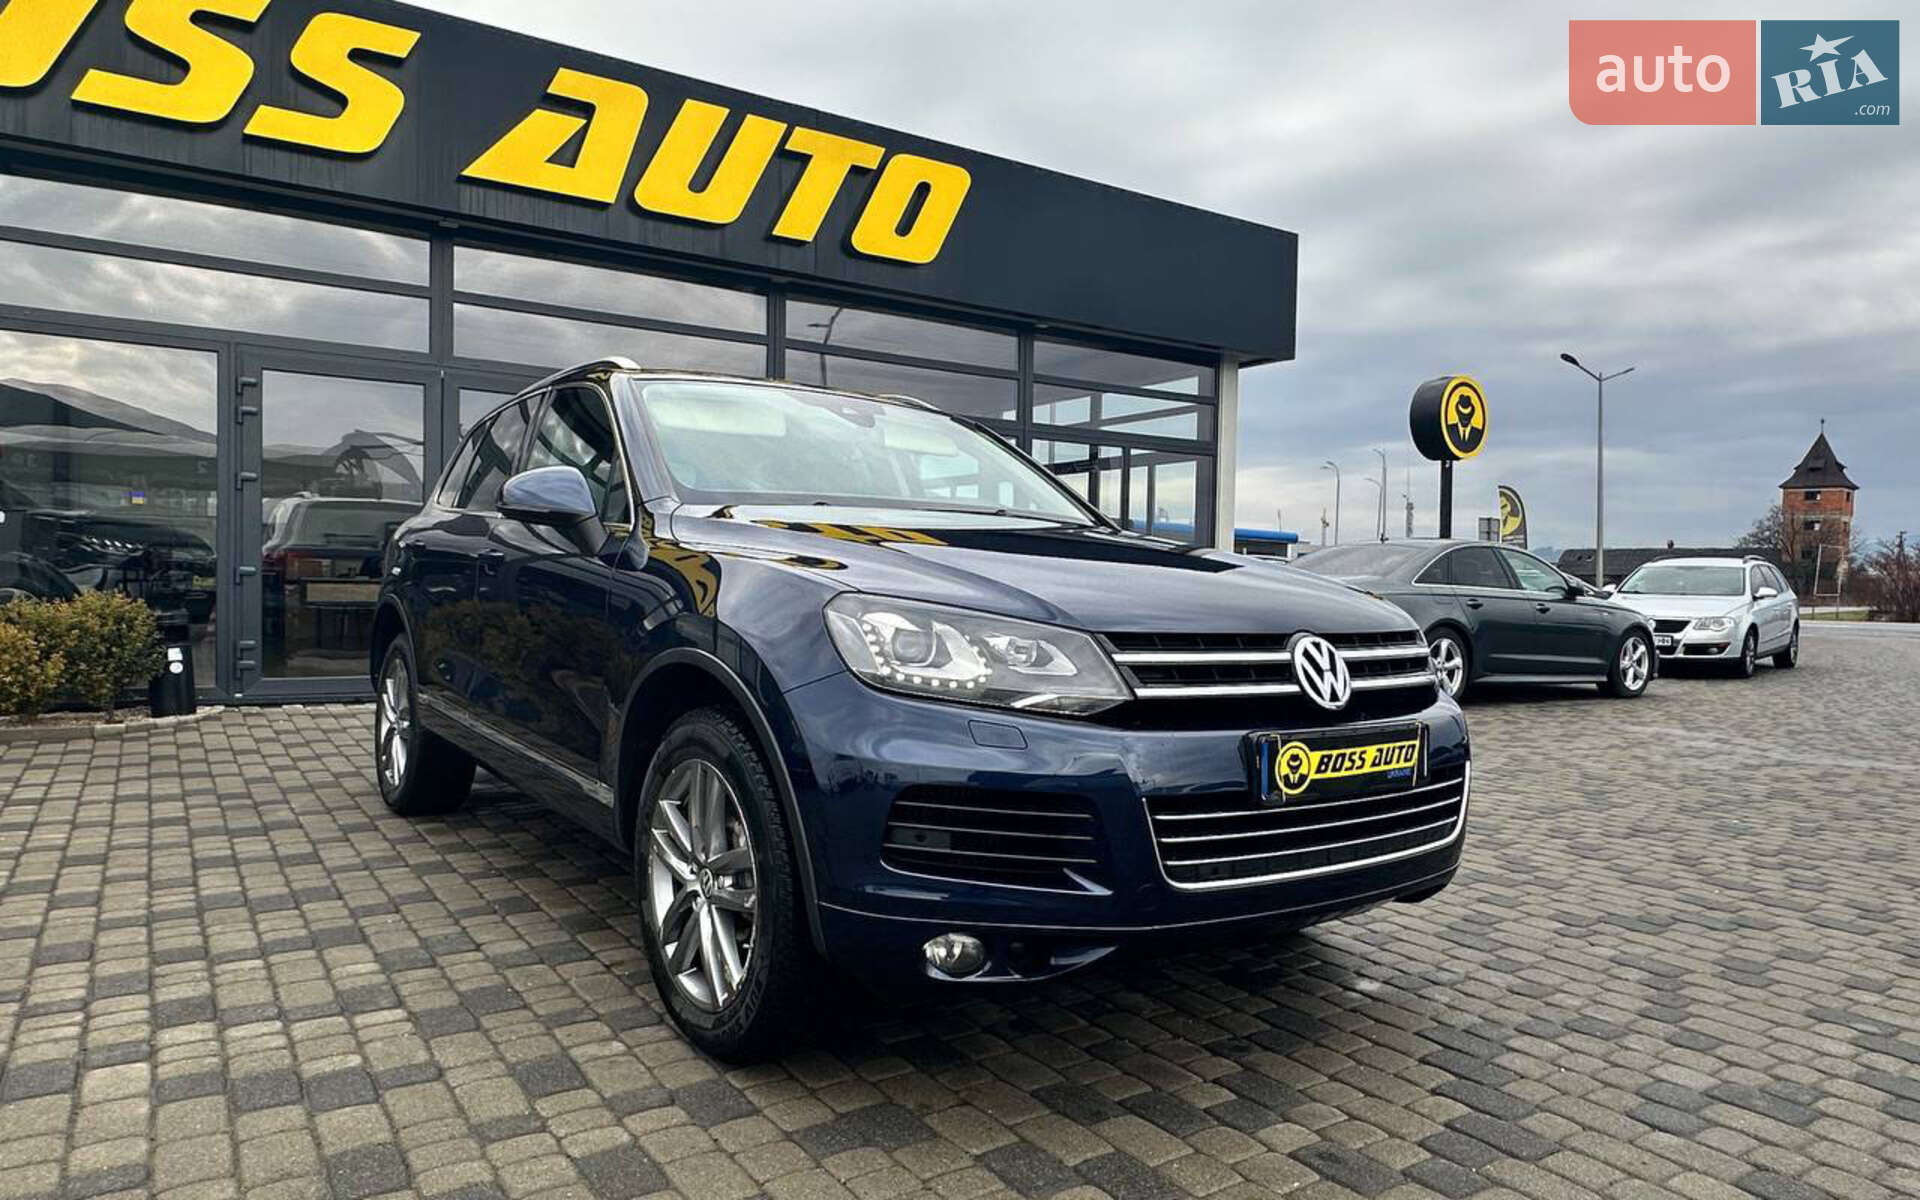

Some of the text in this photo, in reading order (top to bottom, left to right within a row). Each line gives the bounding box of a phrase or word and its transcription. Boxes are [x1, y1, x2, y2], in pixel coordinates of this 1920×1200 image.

[0, 0, 972, 263] SS AUTO
[1315, 750, 1368, 774] BOSS
[1369, 744, 1417, 768] AUTO
